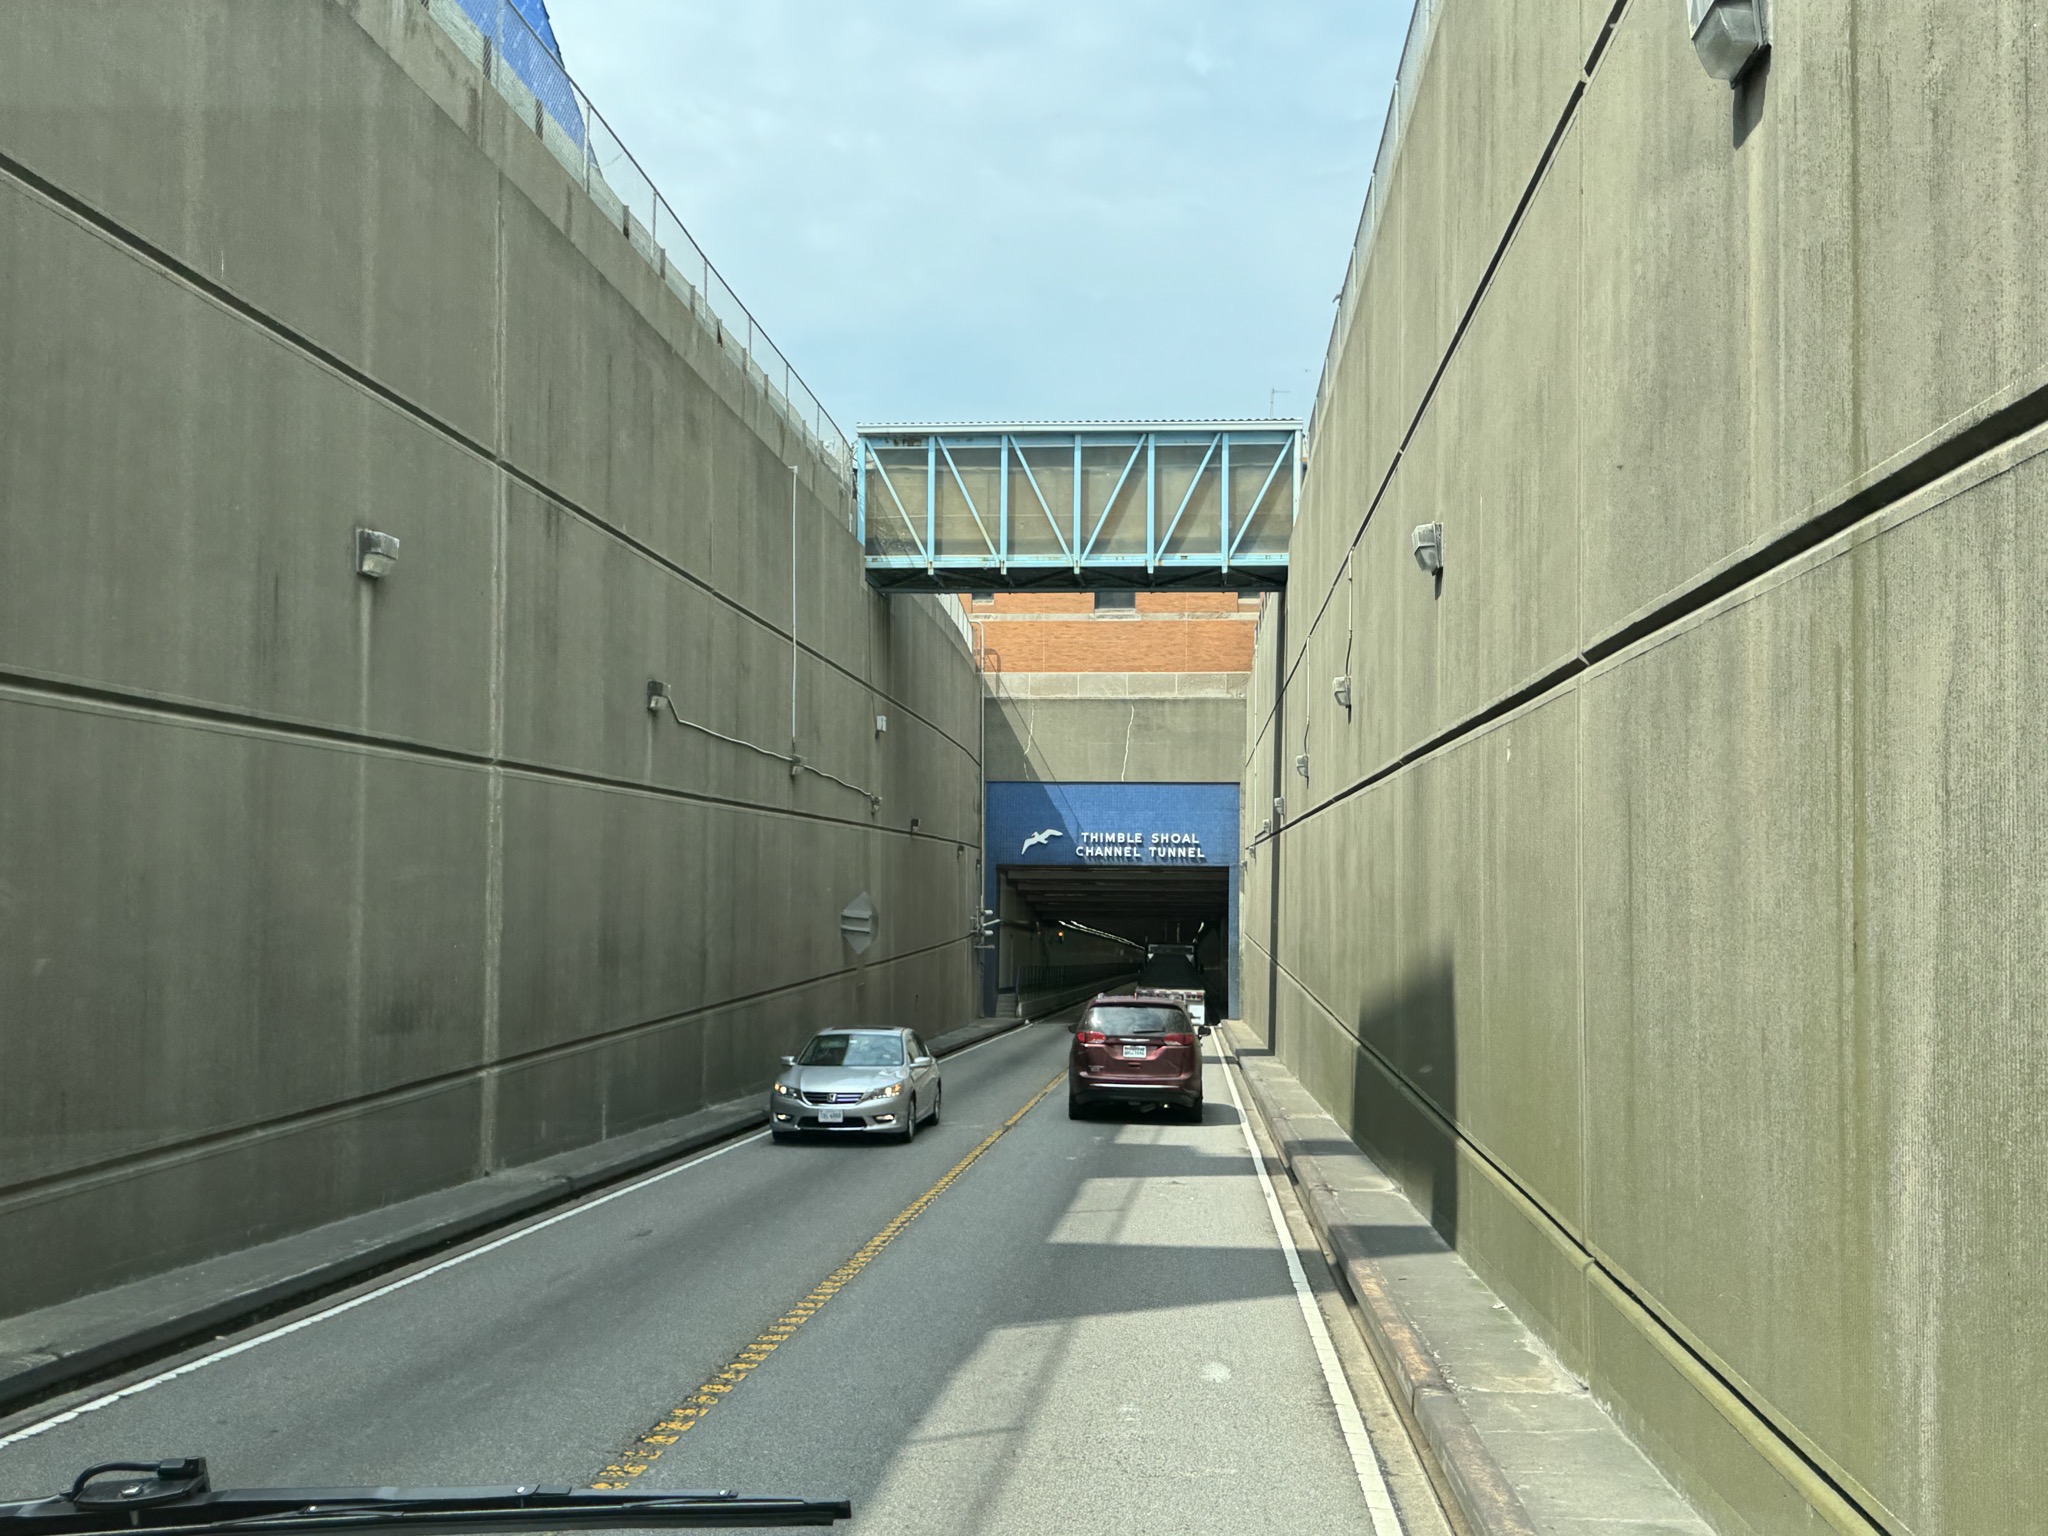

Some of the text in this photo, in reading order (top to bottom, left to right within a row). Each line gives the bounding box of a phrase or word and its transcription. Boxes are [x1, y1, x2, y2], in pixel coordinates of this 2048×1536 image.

[1081, 832, 1199, 844] THIMBLE SHOAL
[1075, 846, 1205, 858] CHANNEL TUNNEL
